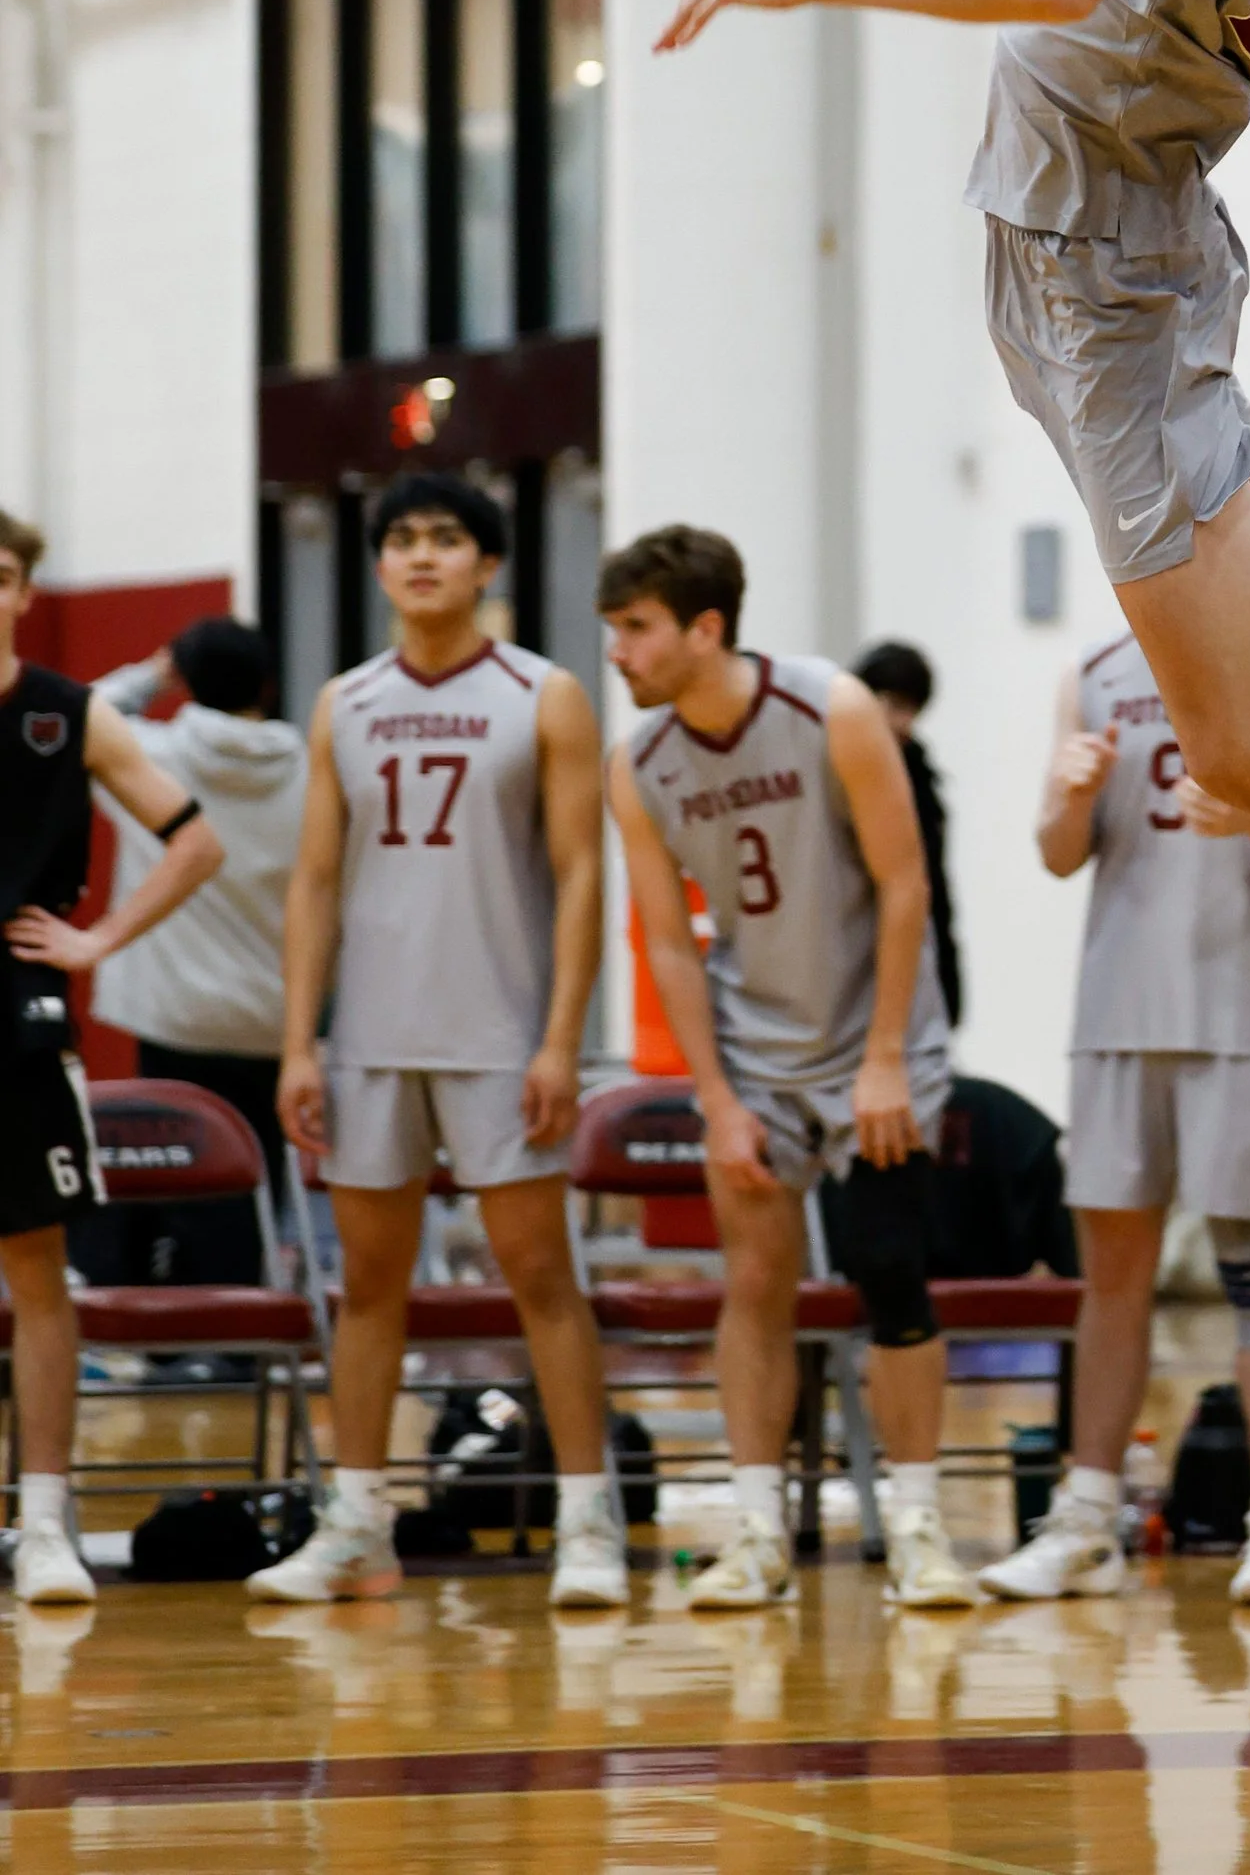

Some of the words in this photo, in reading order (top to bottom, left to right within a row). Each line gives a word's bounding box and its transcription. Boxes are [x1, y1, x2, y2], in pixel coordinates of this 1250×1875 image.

[367, 713, 489, 743] POTSDAM
[378, 754, 469, 846] 17
[681, 770, 803, 826] POTSDAM
[736, 826, 780, 915] 3
[46, 1144, 82, 1199] 6
[98, 1145, 193, 1168] EARS
